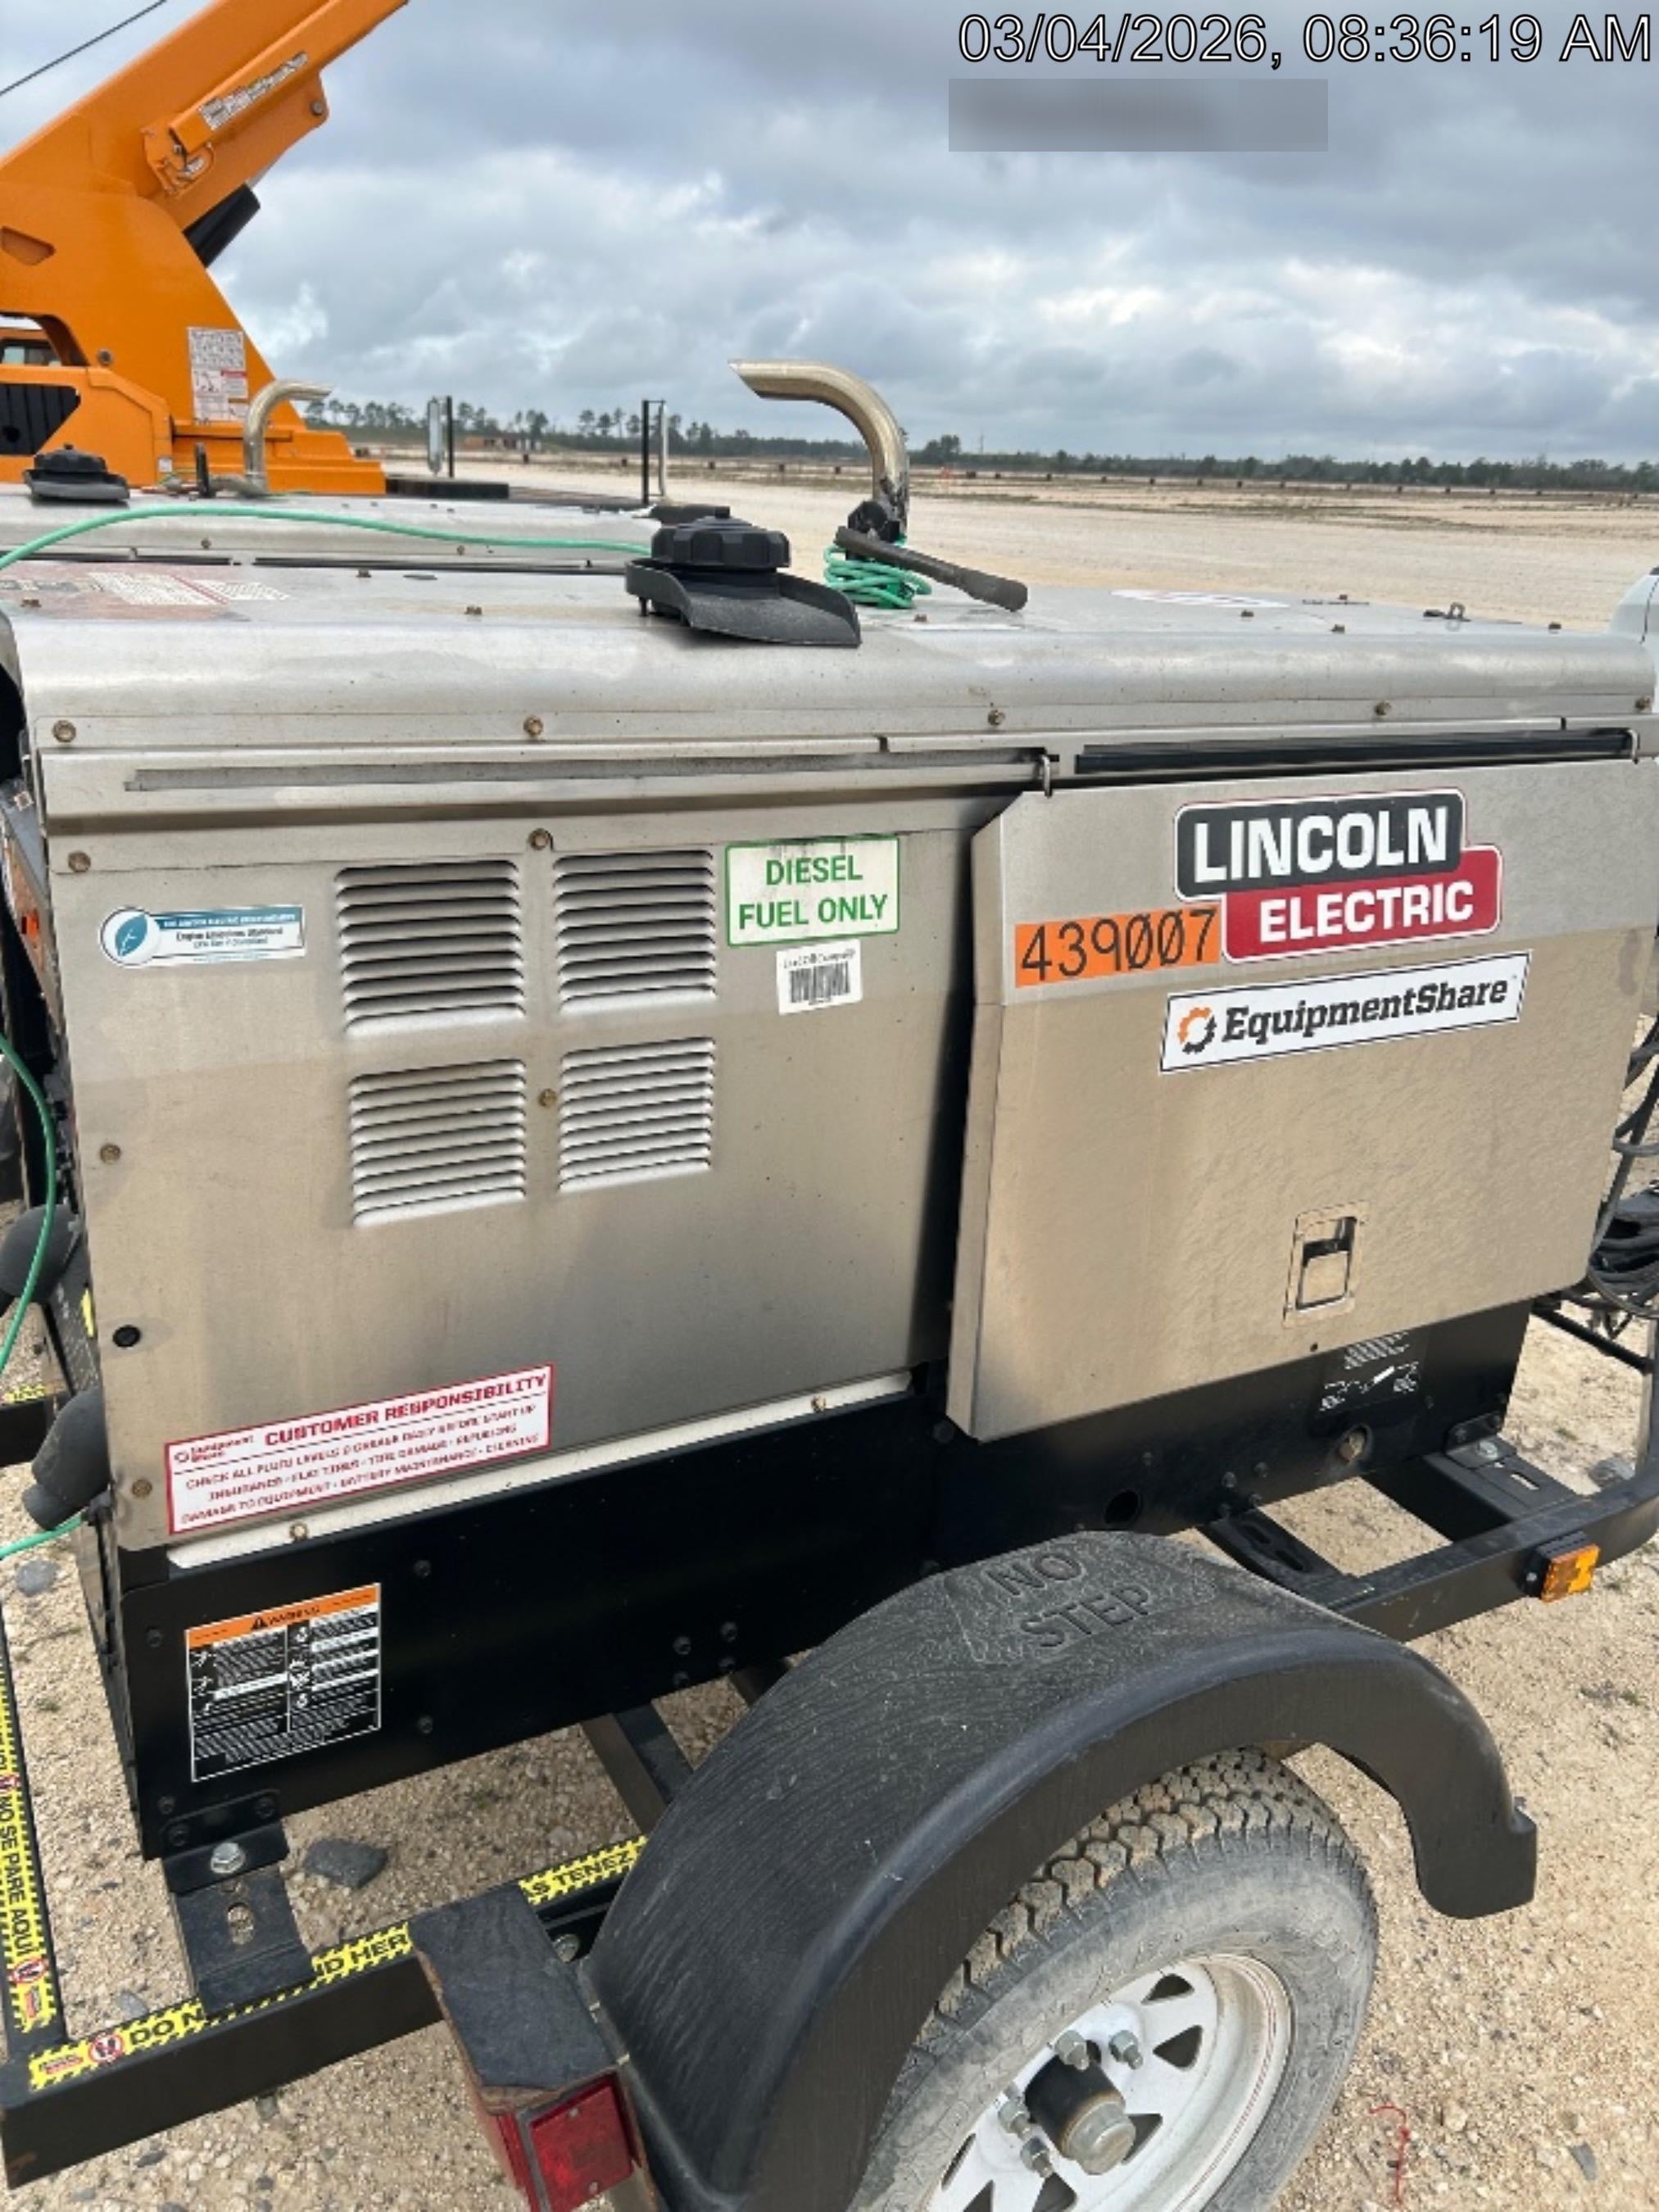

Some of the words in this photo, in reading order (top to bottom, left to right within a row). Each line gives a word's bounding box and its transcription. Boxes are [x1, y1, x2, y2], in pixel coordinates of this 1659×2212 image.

[765, 854, 863, 886] DIESEL
[1193, 806, 1448, 883] LINCOLN
[739, 900, 809, 930] FUEL
[818, 894, 888, 923] ONLY
[1259, 880, 1474, 944] ELECTRIC
[1021, 908, 1218, 982] 439007
[1222, 977, 1509, 1046] EquipmentShare
[265, 1410, 379, 1446] CUSTOMER
[384, 1373, 546, 1421] RESPONSIBILITY
[986, 1556, 1084, 1596] NO
[1021, 1585, 1151, 1648] STEP
[0, 1824, 18, 1851] SE
[4, 1852, 26, 1905] PARE
[351, 1933, 409, 1965] HER
[129, 2019, 175, 2046] DO
